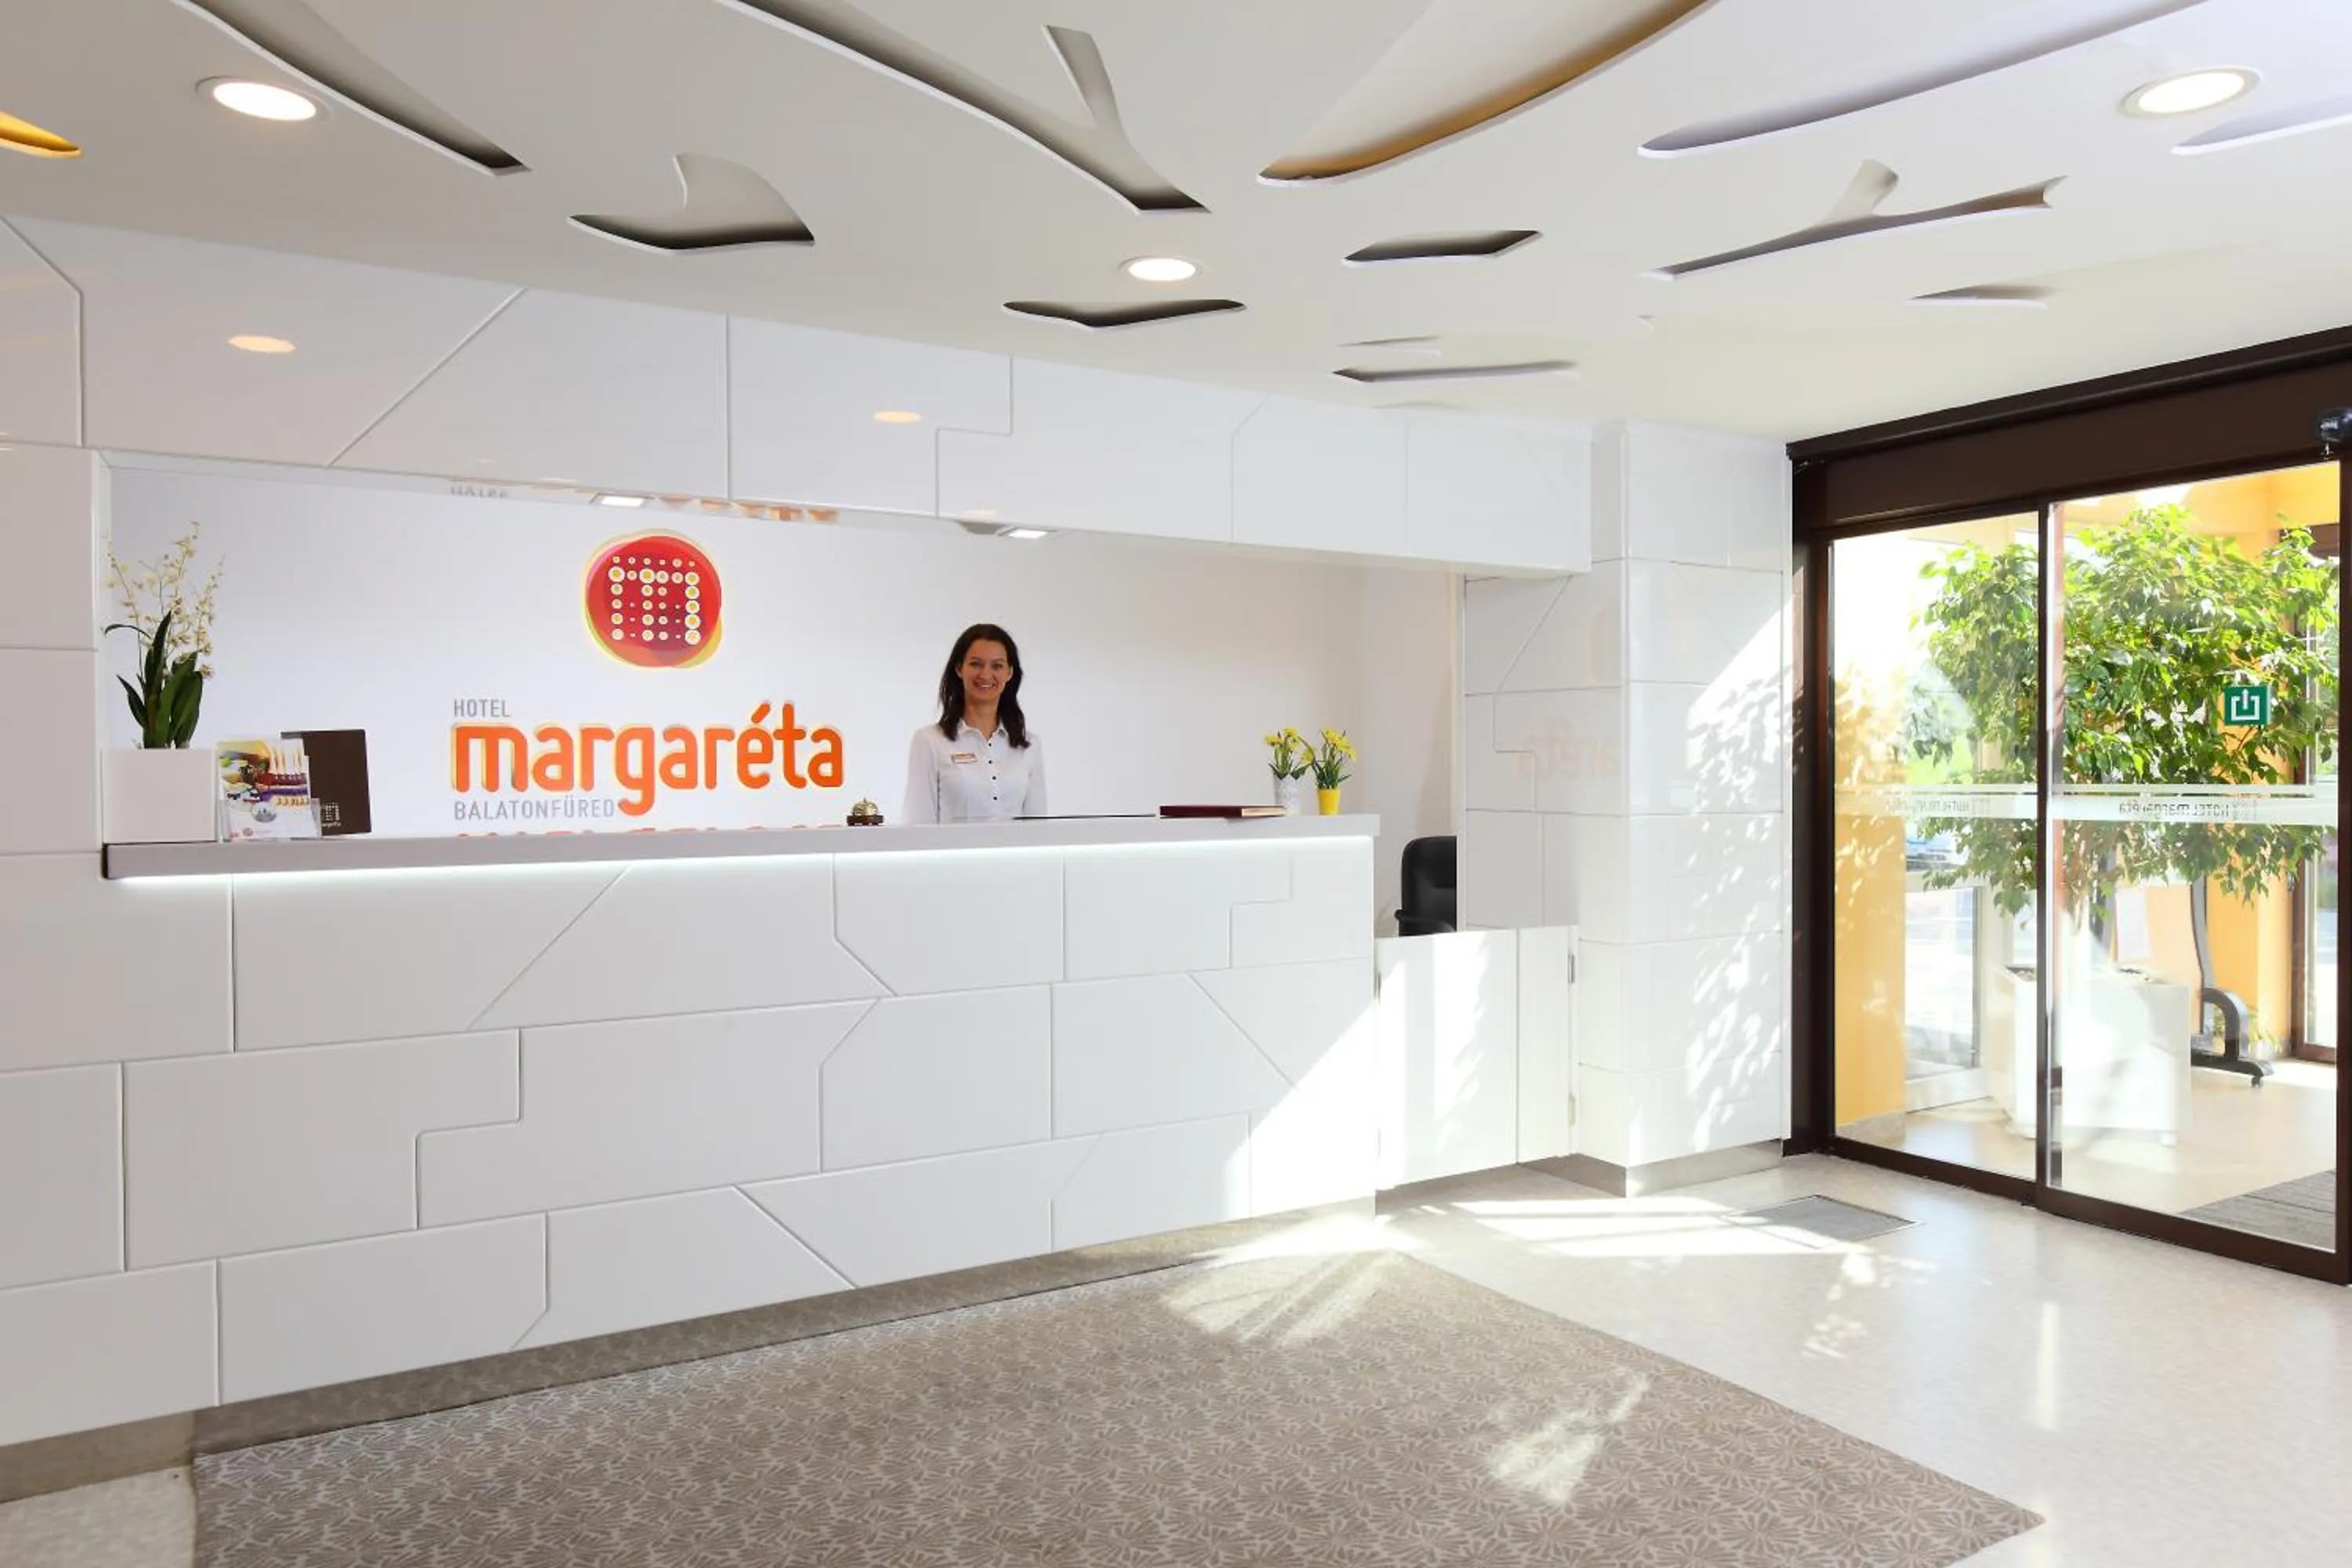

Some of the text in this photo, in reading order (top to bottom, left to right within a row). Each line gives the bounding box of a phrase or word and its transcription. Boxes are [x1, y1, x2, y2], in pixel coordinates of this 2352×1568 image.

[454, 699, 511, 718] HOTEL
[452, 702, 844, 816] margaréta
[454, 795, 615, 820] BALATONFÜRED
